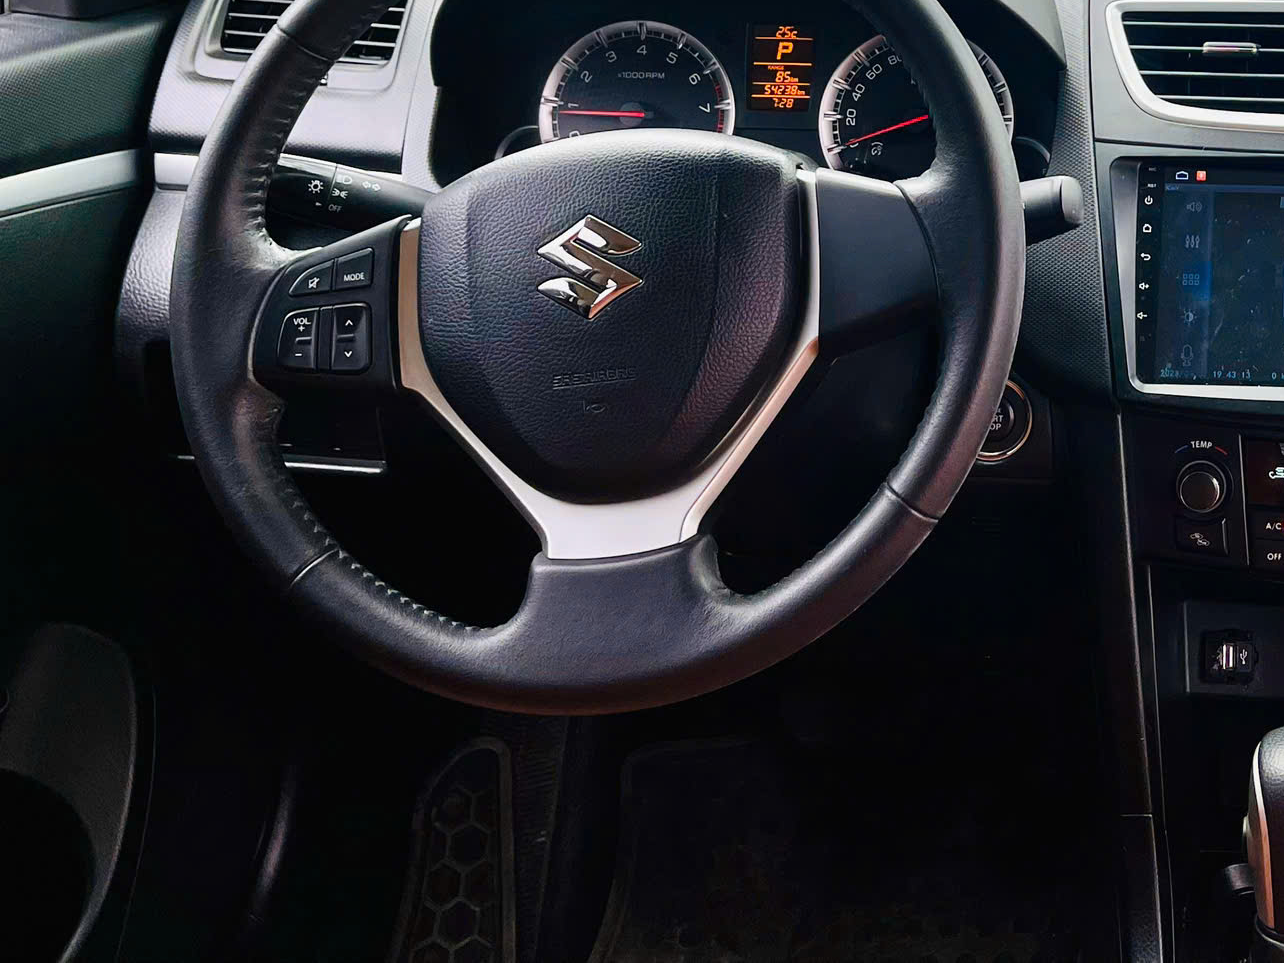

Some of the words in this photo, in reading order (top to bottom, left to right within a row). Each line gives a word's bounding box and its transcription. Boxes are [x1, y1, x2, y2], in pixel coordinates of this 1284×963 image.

[636, 44, 648, 56] 4
[776, 41, 794, 60] P
[605, 50, 618, 63] 3
[666, 52, 679, 64] 5
[580, 70, 593, 84] 2
[865, 63, 883, 81] 60
[688, 72, 701, 85] 6
[852, 83, 866, 102] 40
[567, 101, 579, 109] 1
[698, 102, 711, 114] 7
[845, 108, 857, 126] 20
[328, 203, 343, 213] OFF
[343, 272, 365, 282] MODE
[293, 317, 312, 325] VOL
[1190, 440, 1213, 449] TEMP
[1265, 522, 1282, 530] A/C
[1266, 552, 1282, 561] OFF
